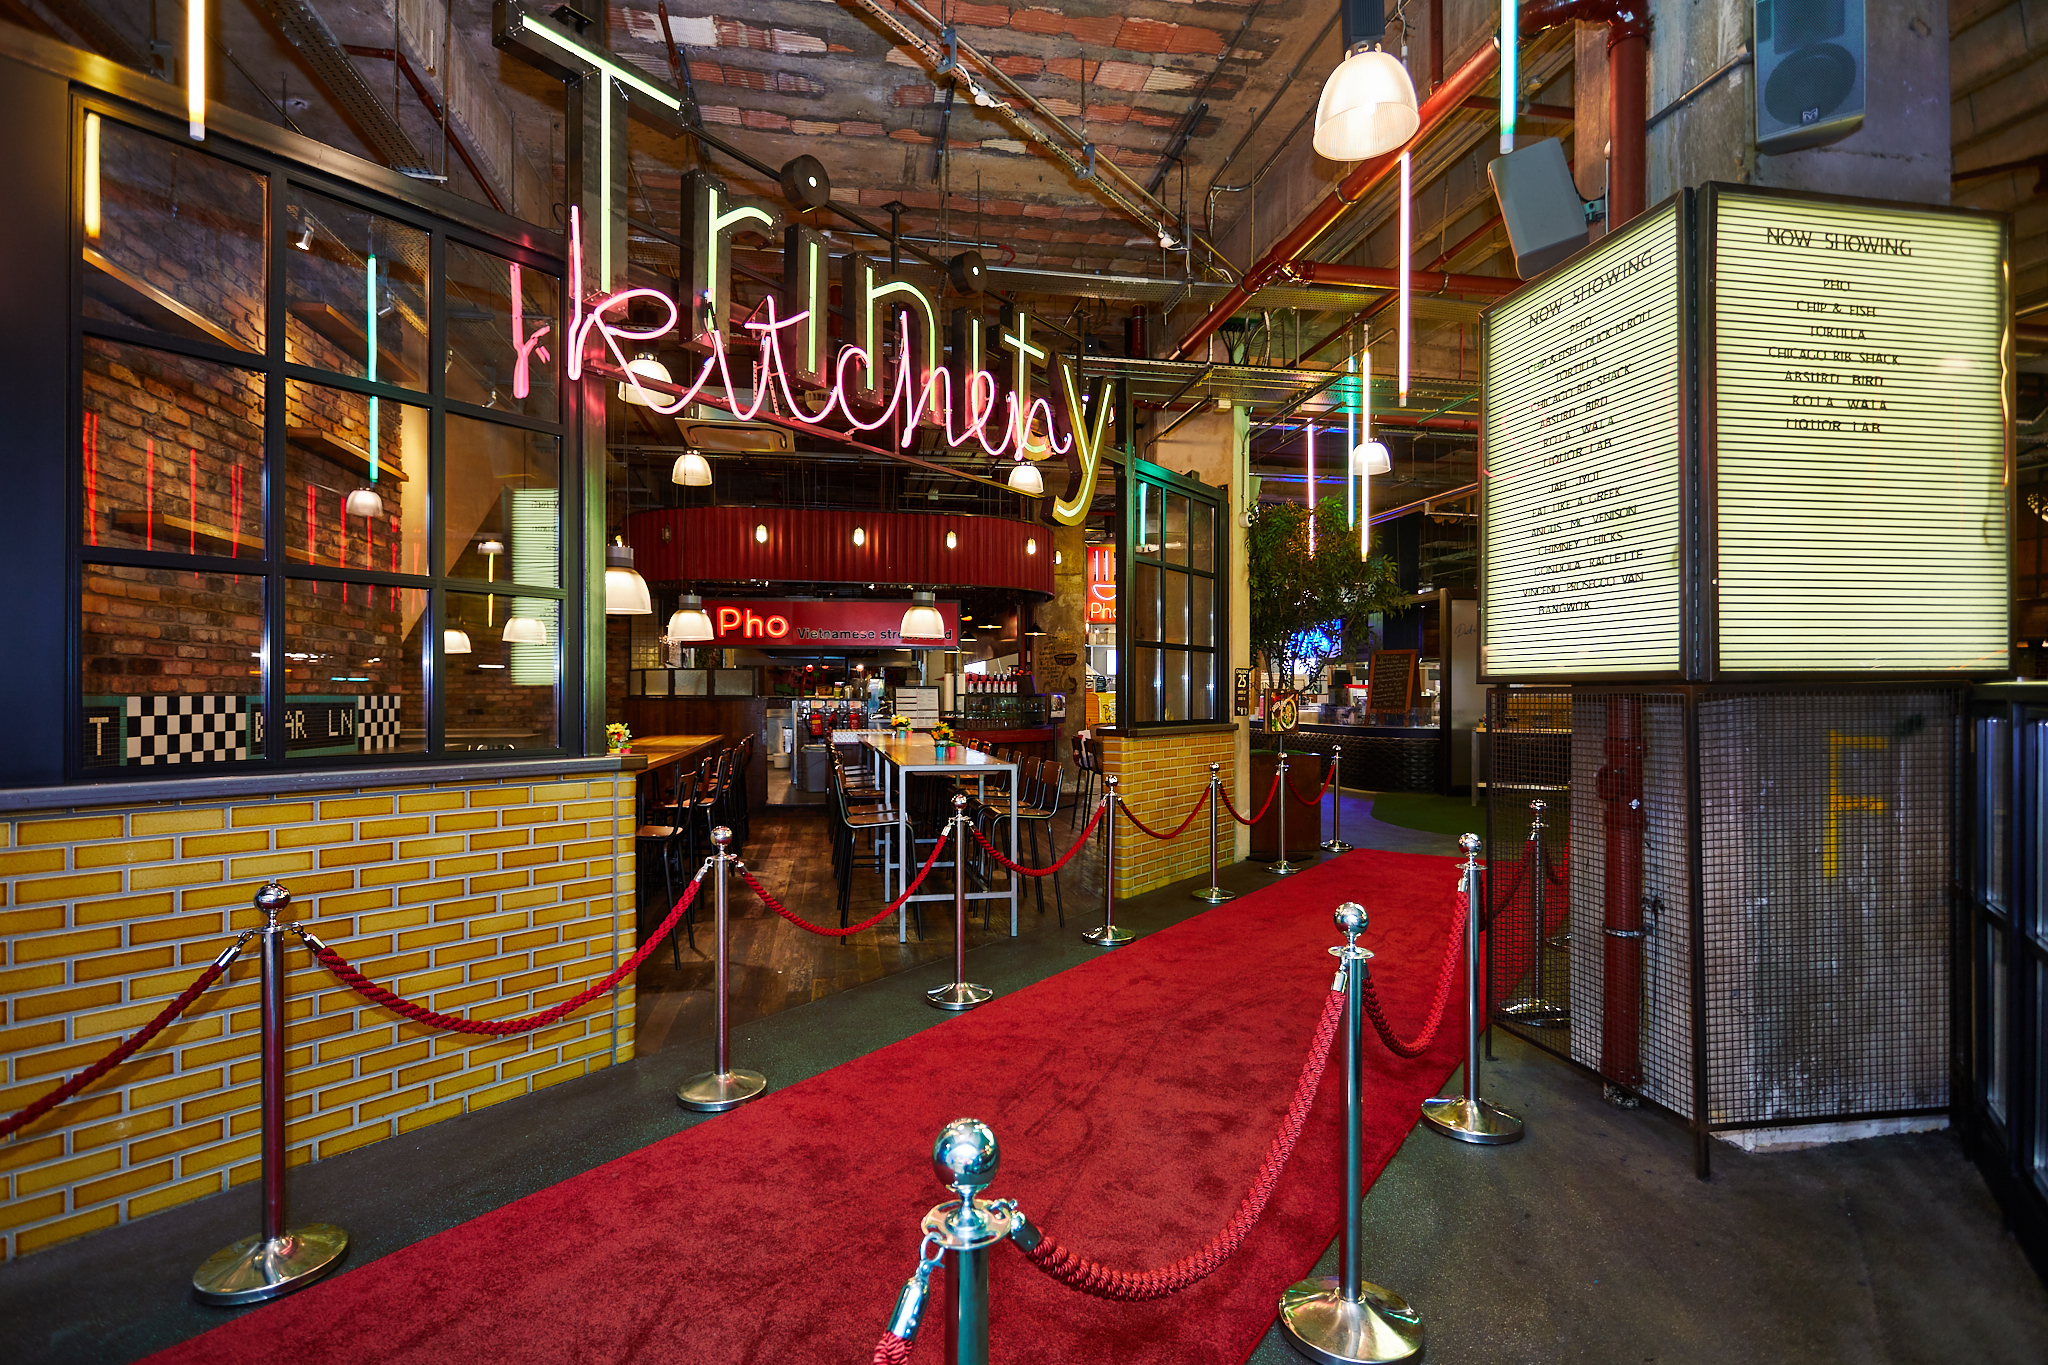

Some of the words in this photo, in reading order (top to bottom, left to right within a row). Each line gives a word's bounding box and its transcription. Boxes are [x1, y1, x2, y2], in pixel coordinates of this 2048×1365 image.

[1767, 227, 1812, 247] NOW
[1825, 233, 1912, 256] SHOWING
[498, 3, 1114, 525] Trinity
[1529, 298, 1563, 328] NOW
[1572, 249, 1653, 305] SHOWING
[1823, 279, 1851, 292] PHO
[1627, 309, 1651, 328] ROLL
[1796, 300, 1827, 313] CHIP
[1832, 303, 1842, 314] &
[1850, 305, 1876, 317] FISH
[1570, 316, 1592, 335] PHO
[1811, 326, 1867, 340] TORTILLA
[1768, 347, 1827, 361] CHICAGO
[1833, 351, 1852, 362] RIB
[1859, 352, 1900, 366] SHACK
[1555, 356, 1599, 382] TORTILLA
[1785, 371, 1840, 384] ABSURD
[1852, 375, 1884, 387] BIRD
[1530, 388, 1575, 412] CHICAGO
[1577, 380, 1593, 393] RIB
[1597, 364, 1632, 386] SHACK
[1540, 408, 1576, 429] ABSURD
[1585, 396, 1609, 413] BIRD
[1792, 395, 1834, 407] ROLA
[1847, 399, 1888, 411] WALA
[1543, 431, 1571, 448] ROLA
[1581, 416, 1615, 434] WALA
[1786, 418, 1842, 431] LIQUOR
[1853, 422, 1881, 433] LAB
[1543, 447, 1583, 467] LIQUOR
[1588, 438, 1612, 453] LAB
[1549, 481, 1567, 493] JAH
[1531, 508, 1548, 518] EAT
[1553, 501, 1571, 512] LIKE
[1577, 497, 1584, 506] A
[1588, 487, 1621, 503] GREEK
[1531, 522, 1562, 537] ANGUS
[1592, 505, 1637, 523] VENISON
[1538, 539, 1581, 555] CHIMNEY
[1586, 531, 1624, 546] CHICKS
[1534, 561, 1581, 576] GONDOLA
[1589, 550, 1644, 567] RACLETTE
[1566, 577, 1615, 591] PROSECCO
[1621, 571, 1645, 584] VAN
[1538, 600, 1591, 615] BANGWOK
[717, 605, 790, 639] Pho
[797, 628, 875, 640] Vietnamese
[1237, 674, 1247, 688] 25
[255, 710, 307, 742] BAR
[328, 708, 352, 737] LN
